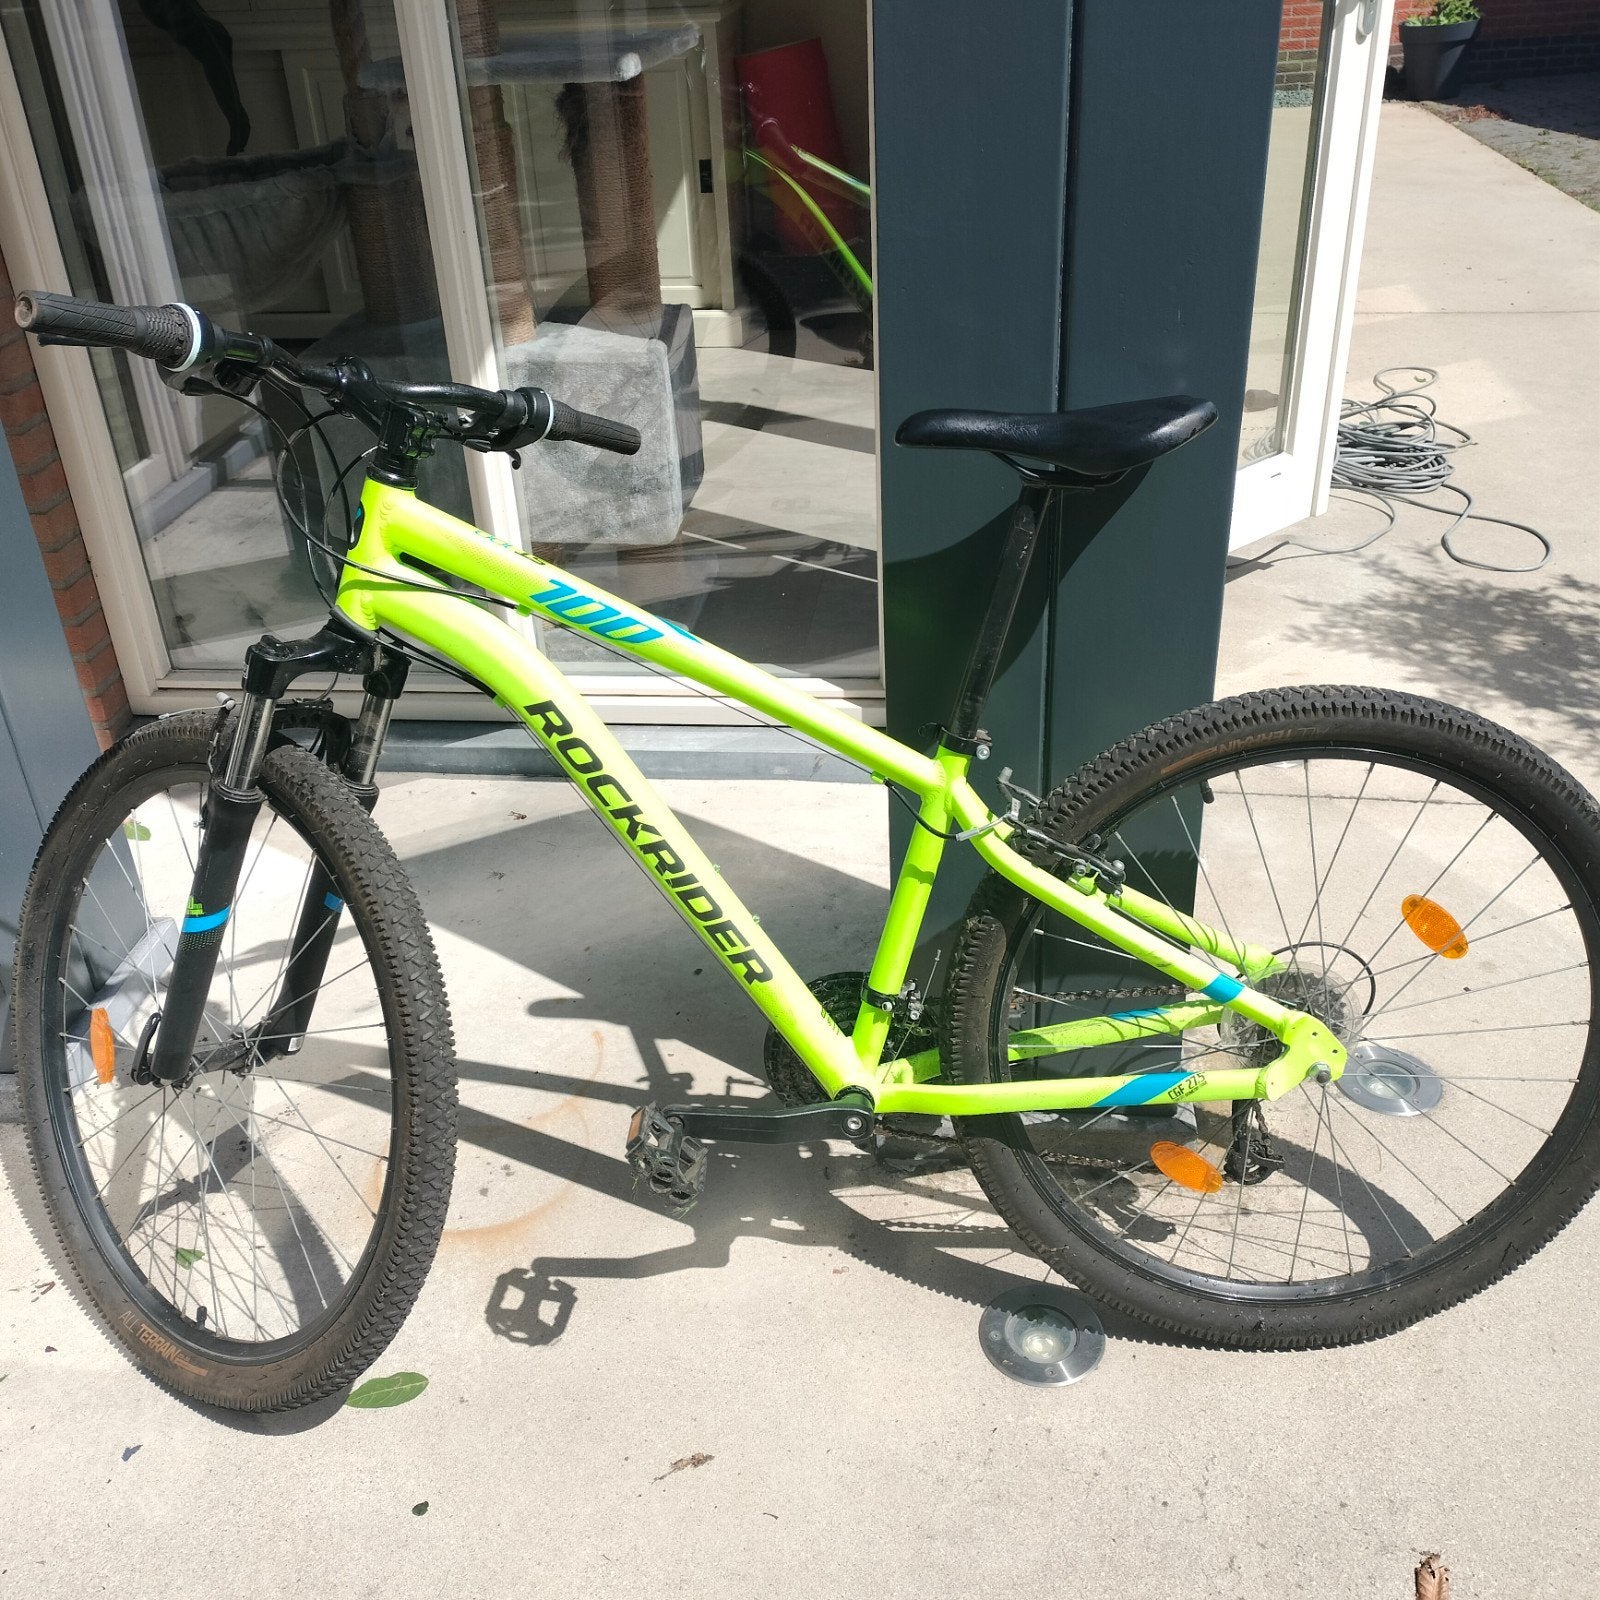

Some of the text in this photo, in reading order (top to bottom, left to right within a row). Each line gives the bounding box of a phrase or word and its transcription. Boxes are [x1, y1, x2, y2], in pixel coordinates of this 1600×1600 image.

[523, 699, 774, 985] ROCKRIDER
[1167, 1083, 1185, 1100] CGF
[118, 1310, 181, 1362] ALL TERRAIN
